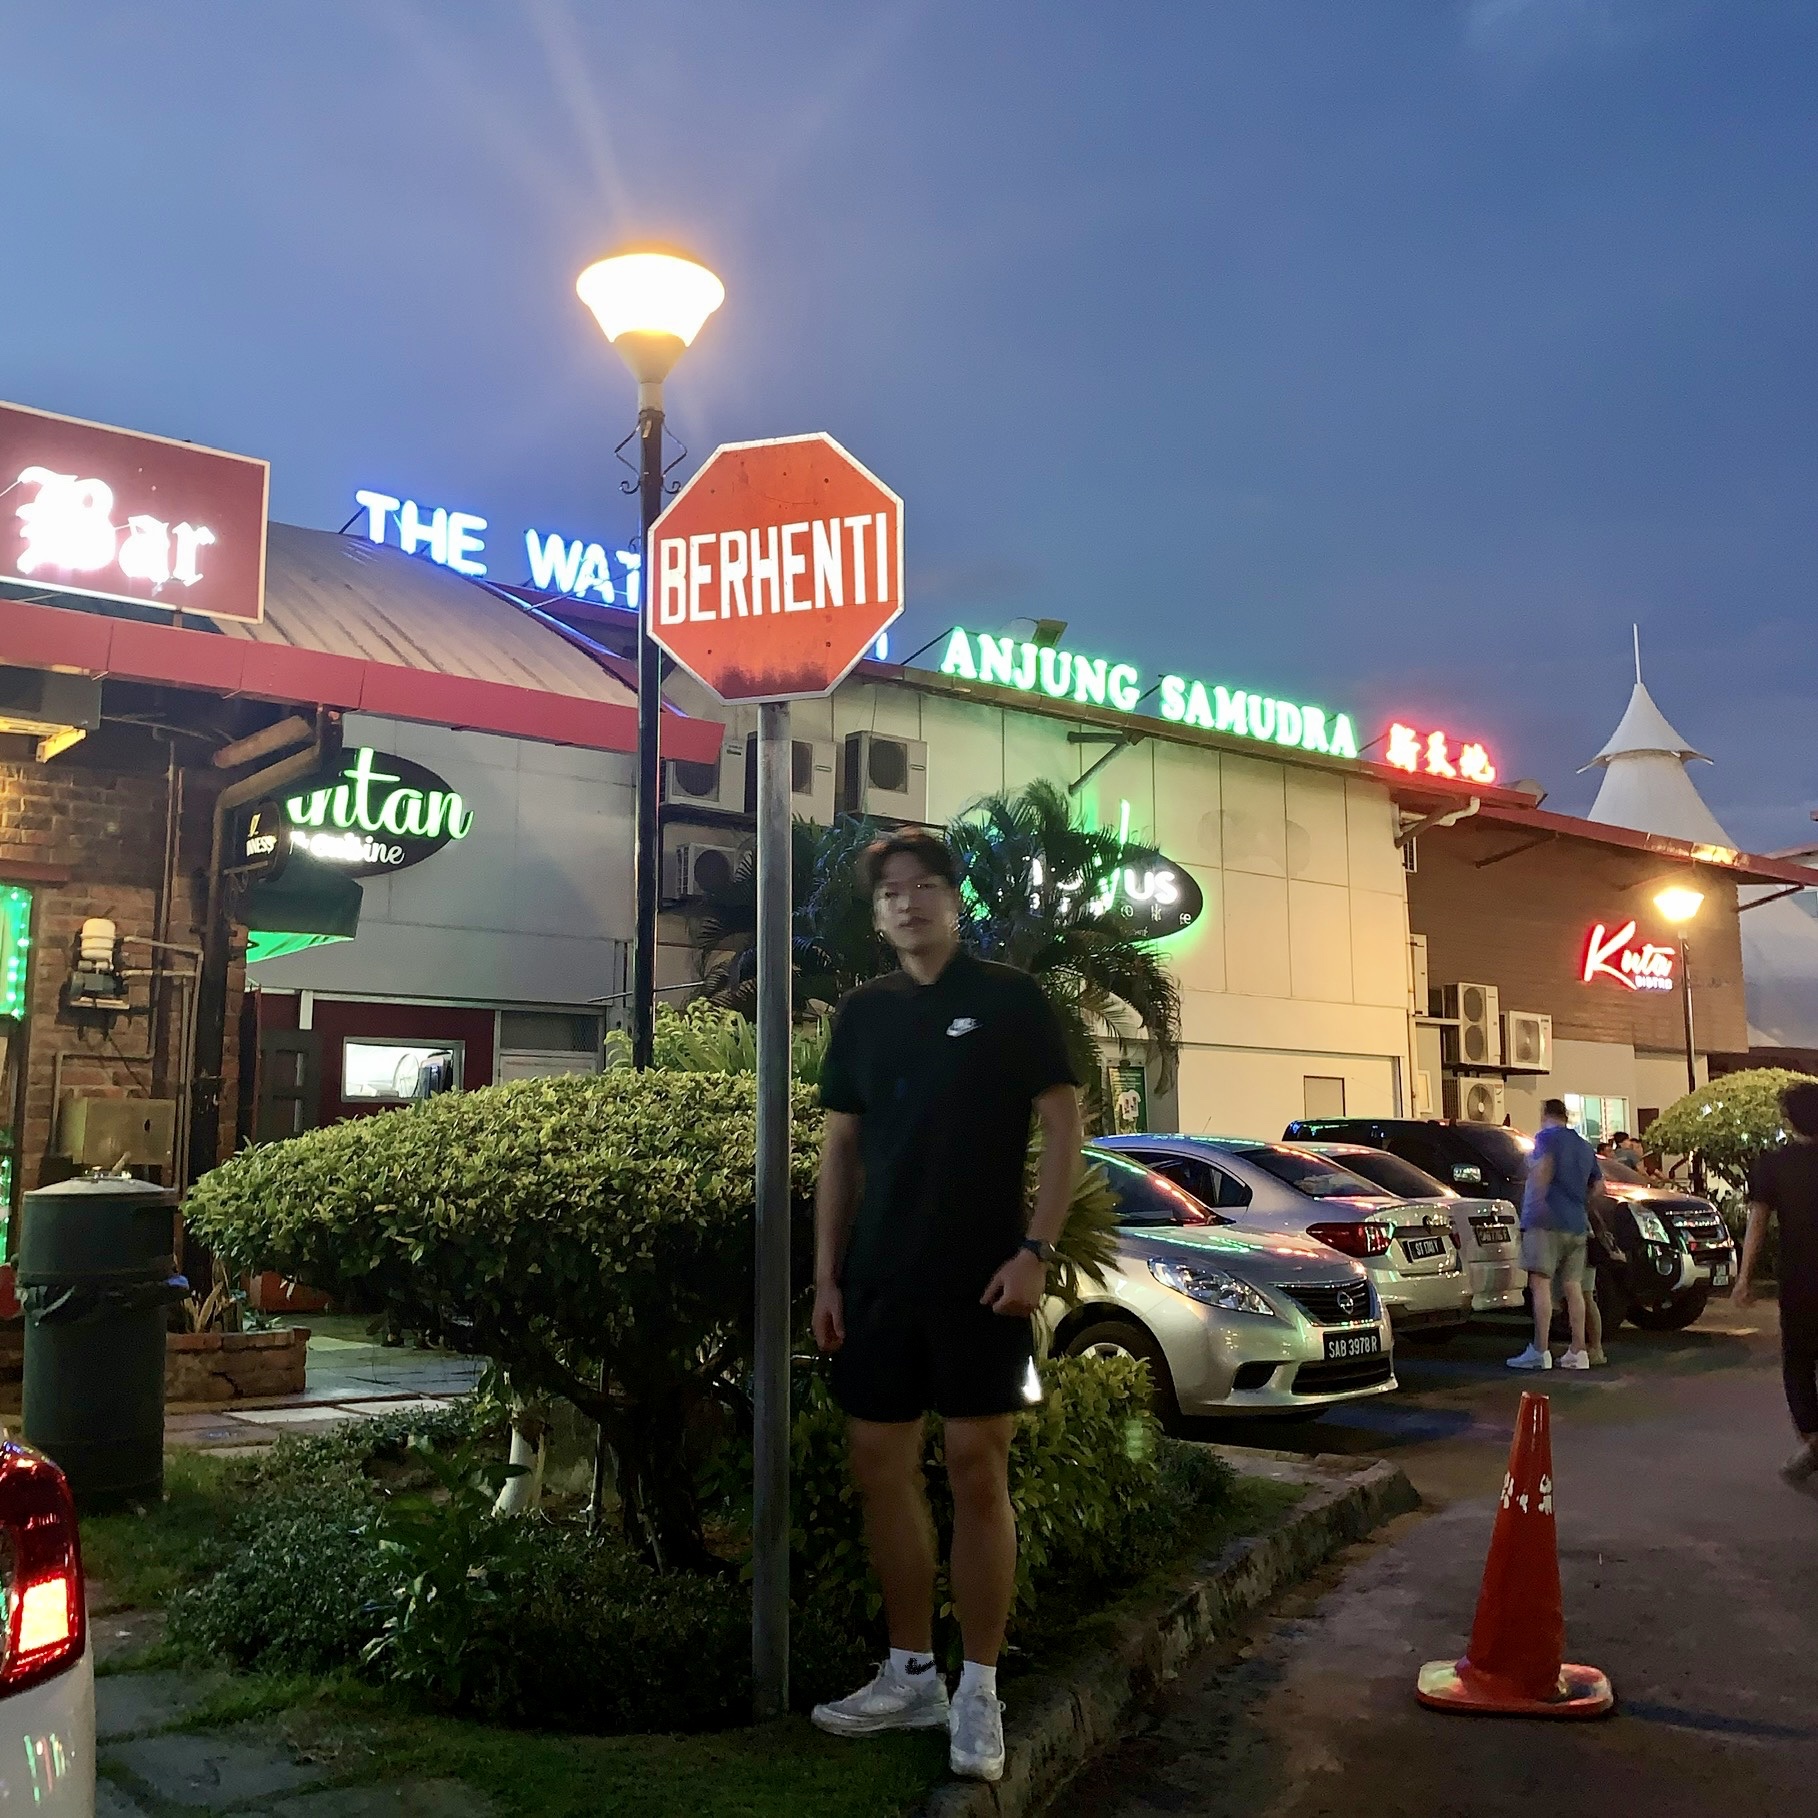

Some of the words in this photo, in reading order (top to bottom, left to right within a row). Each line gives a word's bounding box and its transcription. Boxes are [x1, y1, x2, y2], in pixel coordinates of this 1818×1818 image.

[15, 466, 215, 597] Bar
[355, 489, 488, 577] THE
[660, 512, 888, 625] BERHENTI
[940, 626, 1140, 711] ANJUNG
[1160, 675, 1358, 758] SAMUDRA
[1583, 920, 1676, 990] Kuta
[1328, 1340, 1347, 1358] SAB
[1348, 1337, 1371, 1356] 3978
[1371, 1335, 1378, 1353] R
